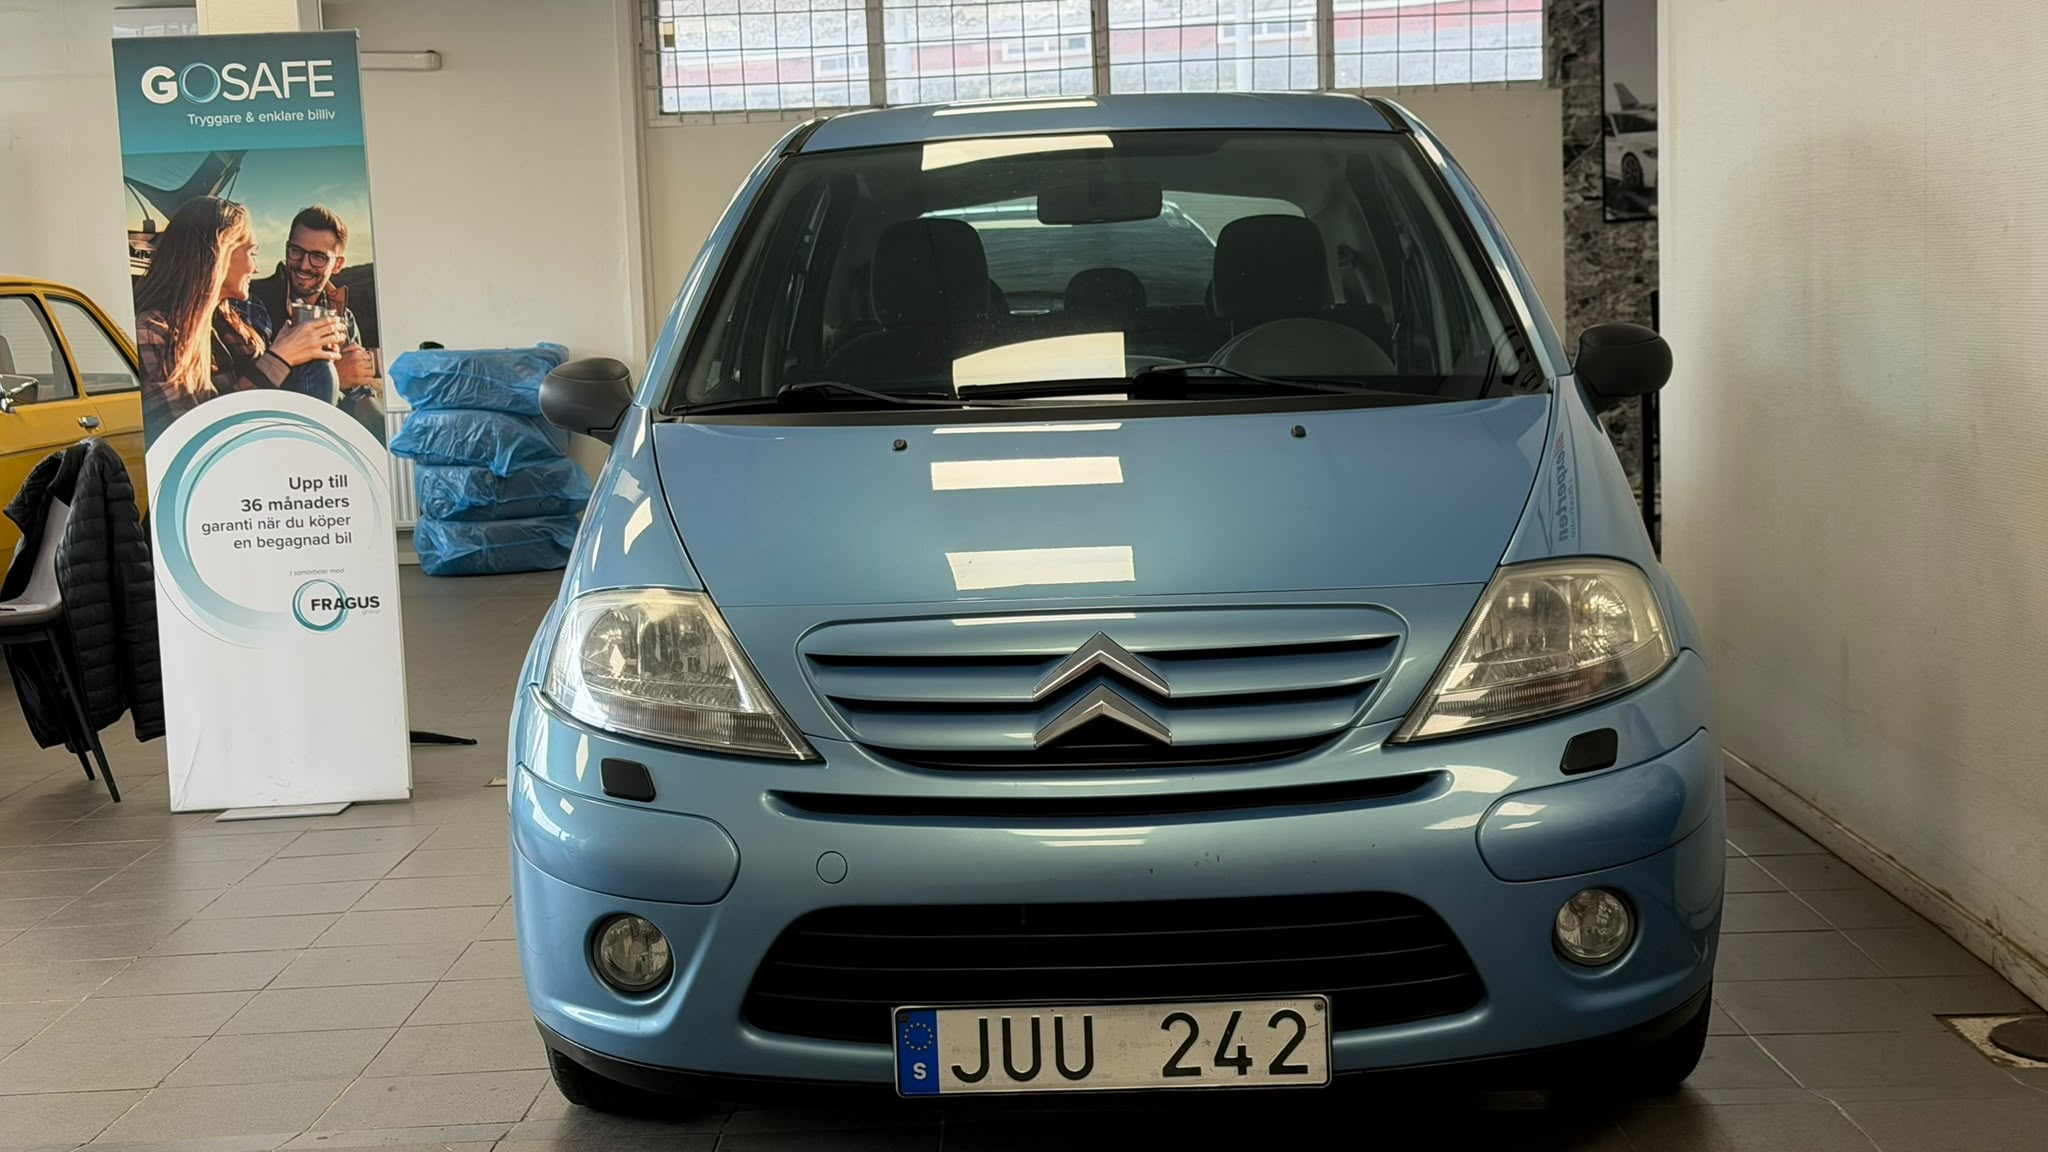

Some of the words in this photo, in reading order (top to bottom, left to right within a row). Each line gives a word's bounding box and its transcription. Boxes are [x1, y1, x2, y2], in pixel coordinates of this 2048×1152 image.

[141, 60, 335, 104] GOSAFE
[187, 112, 242, 128] Tryggare
[246, 112, 255, 123] &
[258, 109, 304, 123] enklare
[308, 108, 336, 121] billiv
[289, 476, 323, 493] Upp
[328, 474, 348, 489] till
[240, 498, 263, 512] 36
[268, 495, 350, 512] månaders
[201, 518, 253, 536] garanti
[257, 517, 281, 531] när
[285, 515, 305, 530] du
[309, 514, 351, 533] köper
[233, 538, 252, 549] en
[256, 533, 330, 551] begagnad
[335, 531, 352, 545] bil
[329, 567, 345, 575] med
[310, 595, 380, 611] FRAGUS
[951, 1015, 1094, 1083] JUU
[1161, 1009, 1309, 1077] 242
[912, 1062, 927, 1081] S
